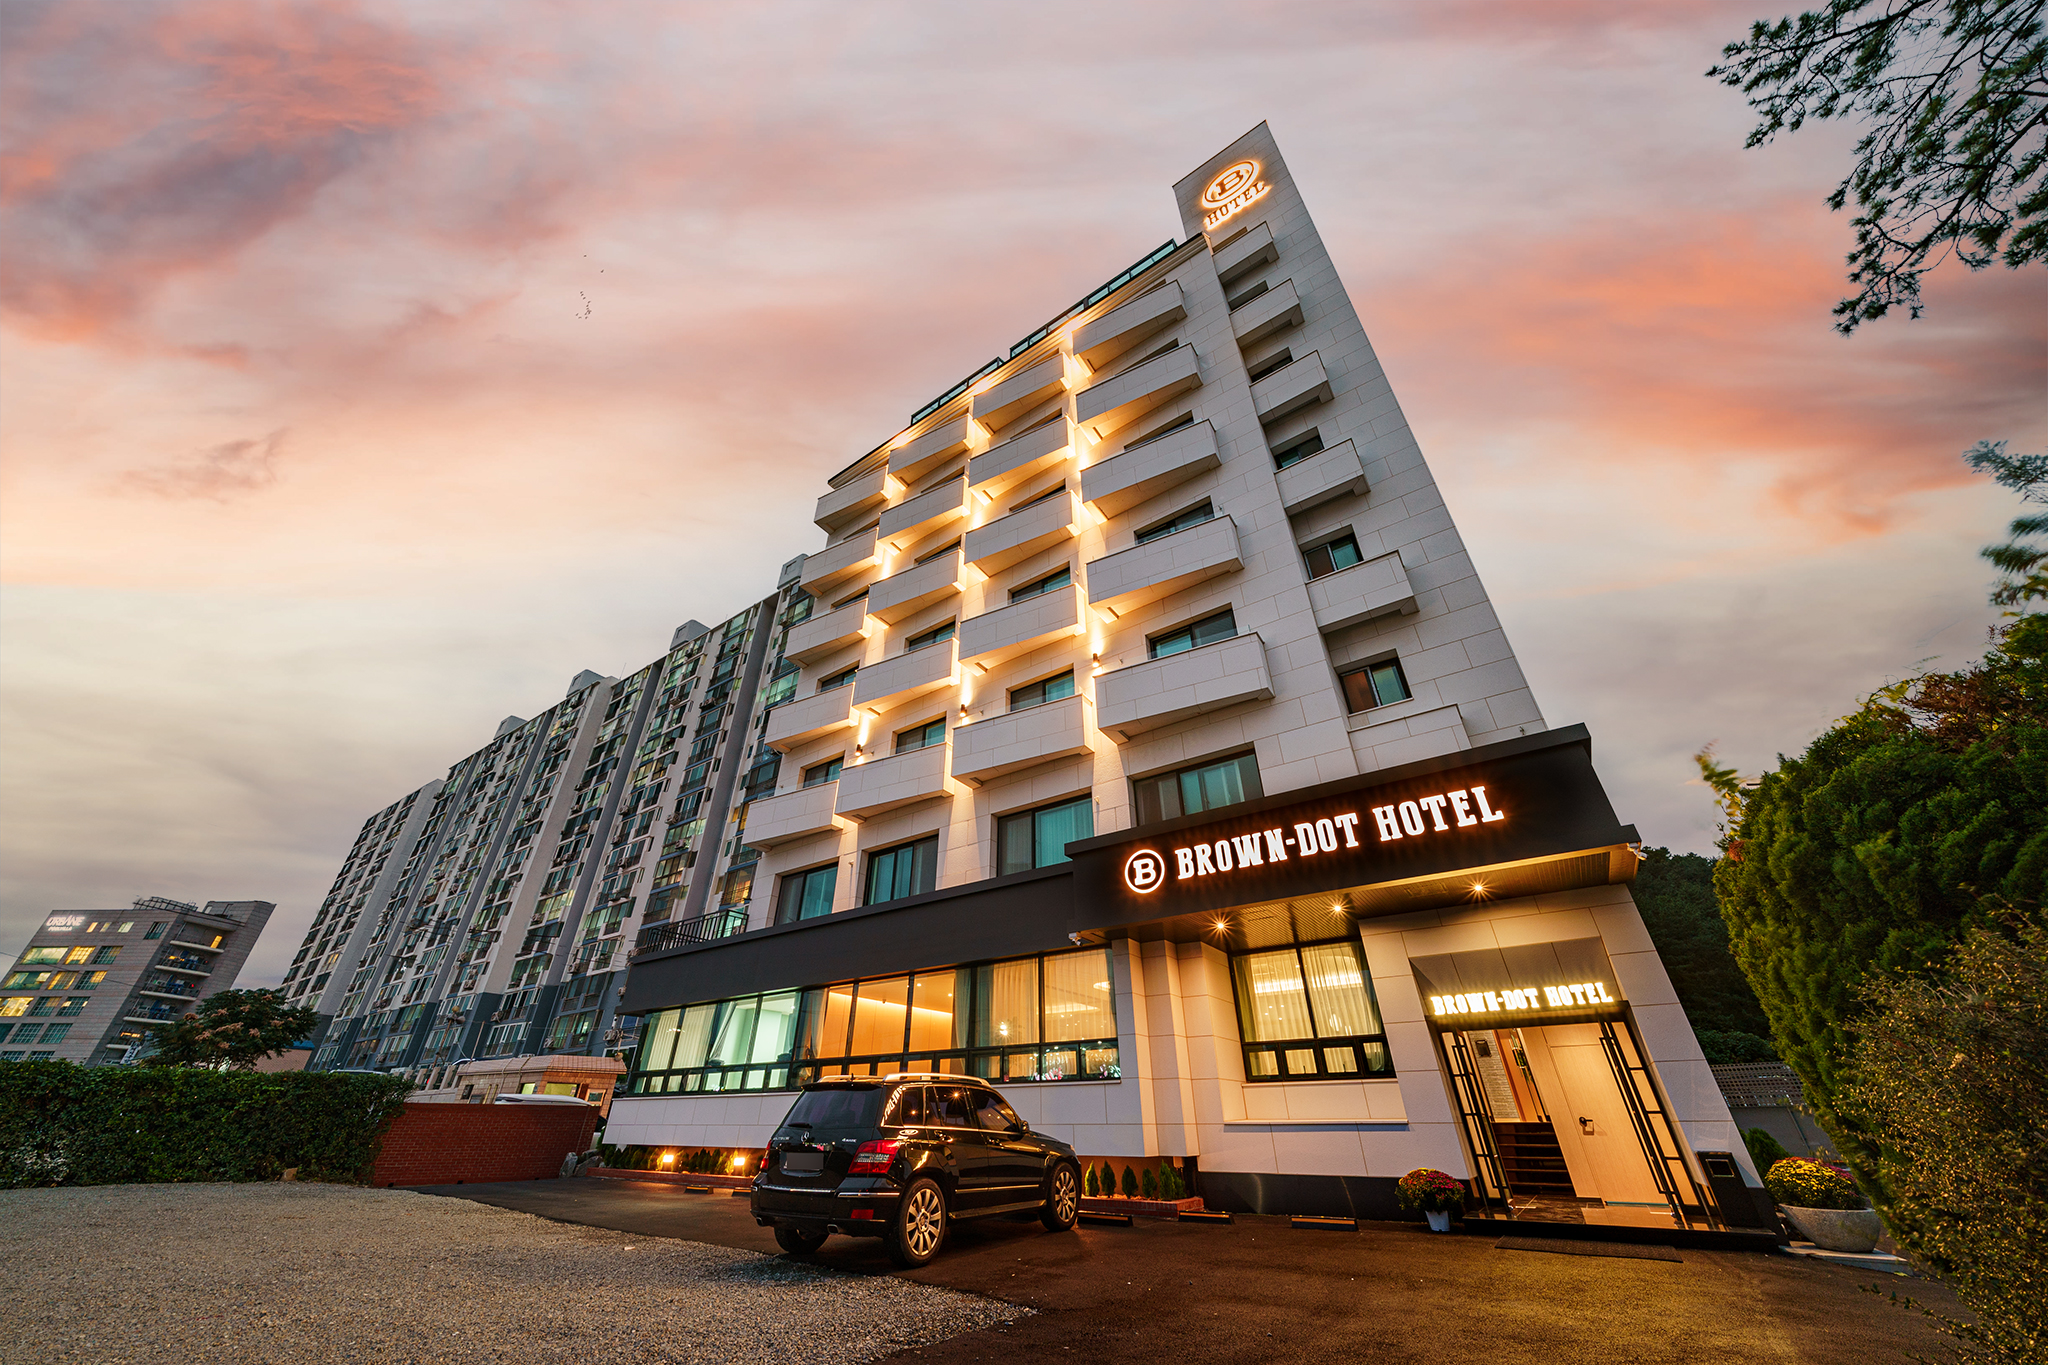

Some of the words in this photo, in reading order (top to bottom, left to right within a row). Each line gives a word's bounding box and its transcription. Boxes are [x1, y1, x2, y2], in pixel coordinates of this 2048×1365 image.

[1206, 182, 1265, 225] HOTEL
[1174, 811, 1359, 880] BROWN-DOT
[1372, 785, 1504, 842] HOTEL
[1430, 988, 1540, 1015] BROWN-DOT
[1544, 982, 1614, 1007] HOTEL
